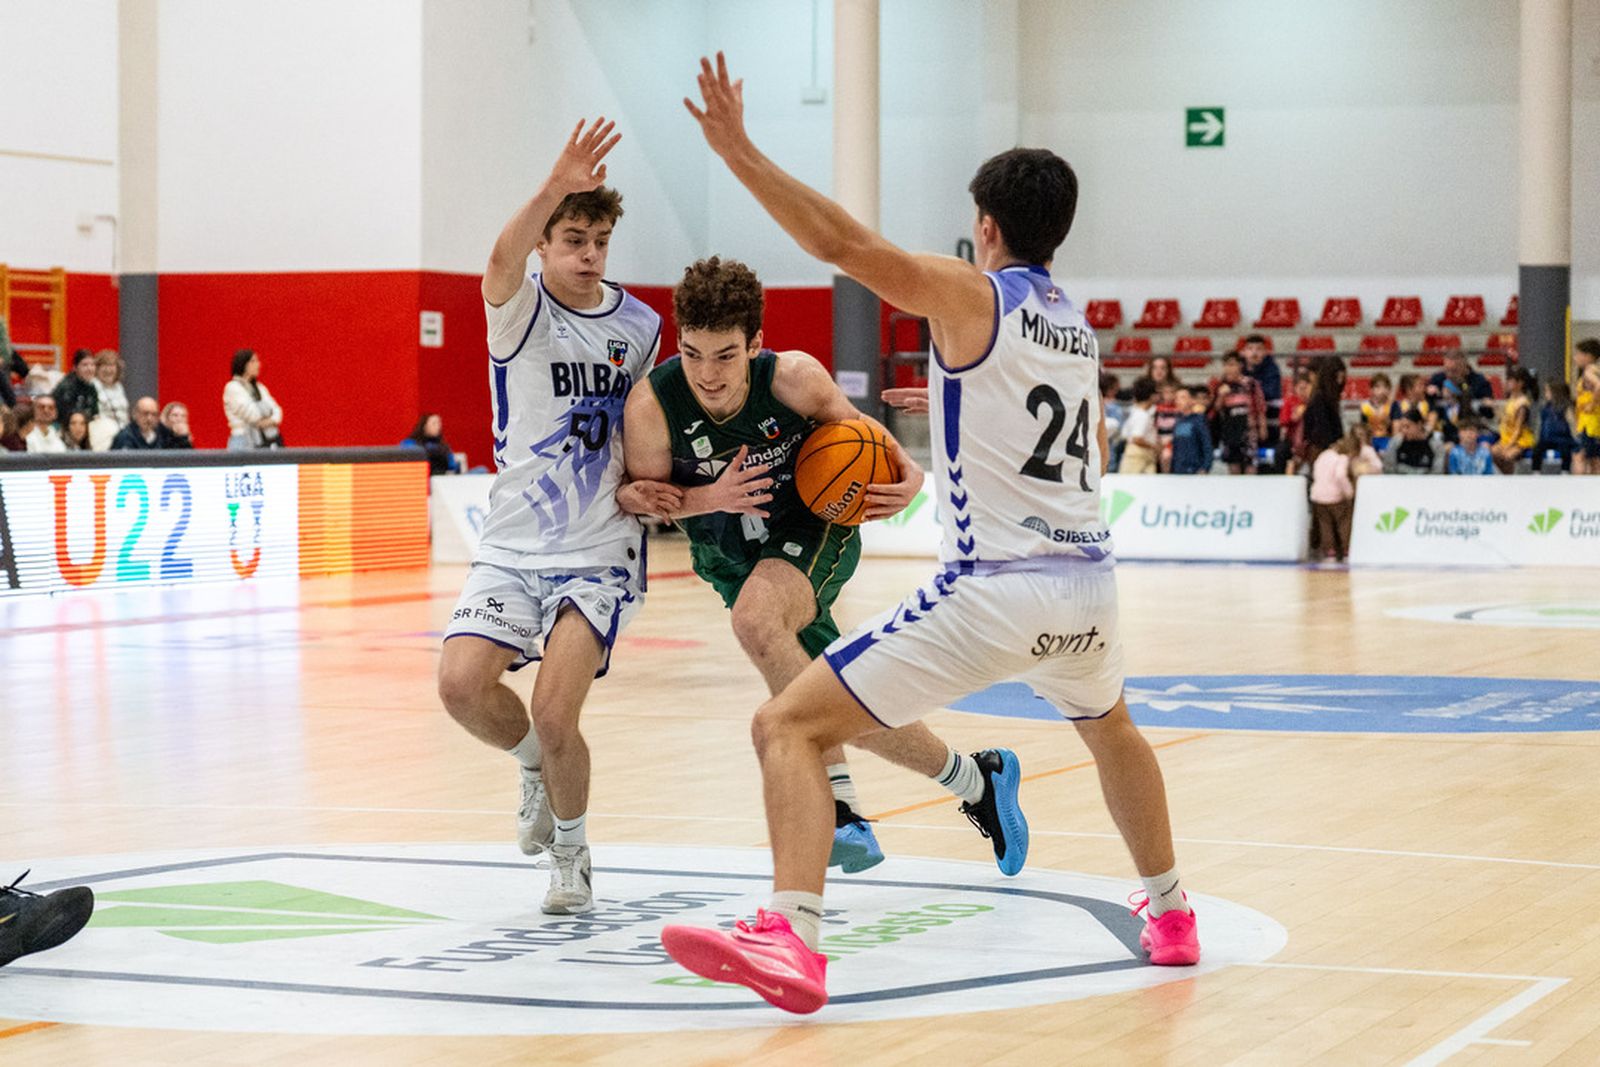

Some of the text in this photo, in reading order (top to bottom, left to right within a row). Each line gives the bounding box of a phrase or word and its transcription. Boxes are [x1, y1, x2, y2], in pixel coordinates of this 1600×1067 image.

[1021, 308, 1096, 359] MINTEG
[562, 410, 609, 453] 50
[1019, 384, 1093, 492] 24
[225, 472, 263, 498] LIGA
[49, 474, 194, 585] U22
[1141, 504, 1254, 536] Unicaja
[1415, 522, 1481, 540] Unicaja
[1416, 508, 1508, 523] Fundación
[474, 608, 531, 638] Financial
[356, 890, 745, 972] Fundación
